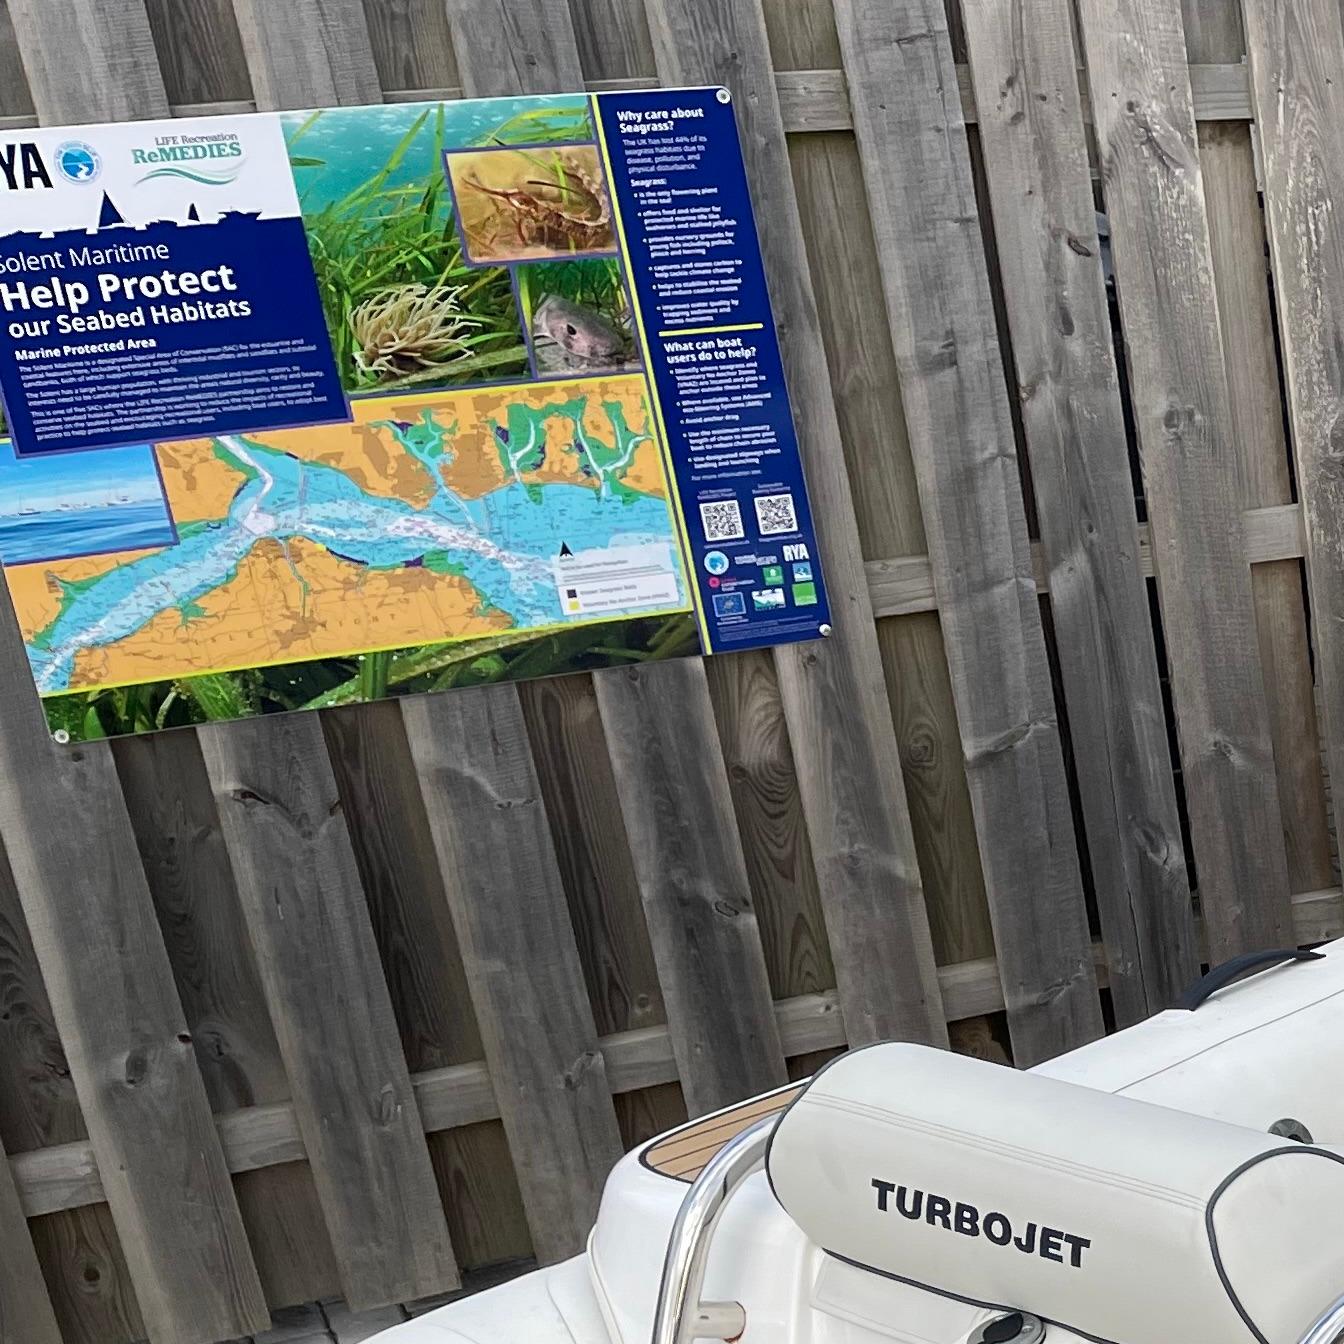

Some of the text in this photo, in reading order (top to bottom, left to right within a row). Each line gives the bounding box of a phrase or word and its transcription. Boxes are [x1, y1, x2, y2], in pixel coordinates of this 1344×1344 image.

[617, 107, 704, 122] Why care about
[620, 120, 674, 134] Seagrass?
[155, 132, 238, 146] LIFE Recreation
[131, 141, 242, 165] ReMEDIES
[69, 241, 170, 268] Maritime
[1, 264, 238, 314] Help Protect
[9, 297, 252, 338] our Seabed Habitats
[14, 337, 157, 361] Marine Protected Area
[664, 337, 742, 353] What can boat
[666, 346, 757, 364] users do to help?
[782, 543, 810, 562] RYA
[870, 1178, 1092, 1269] TURBOJET
